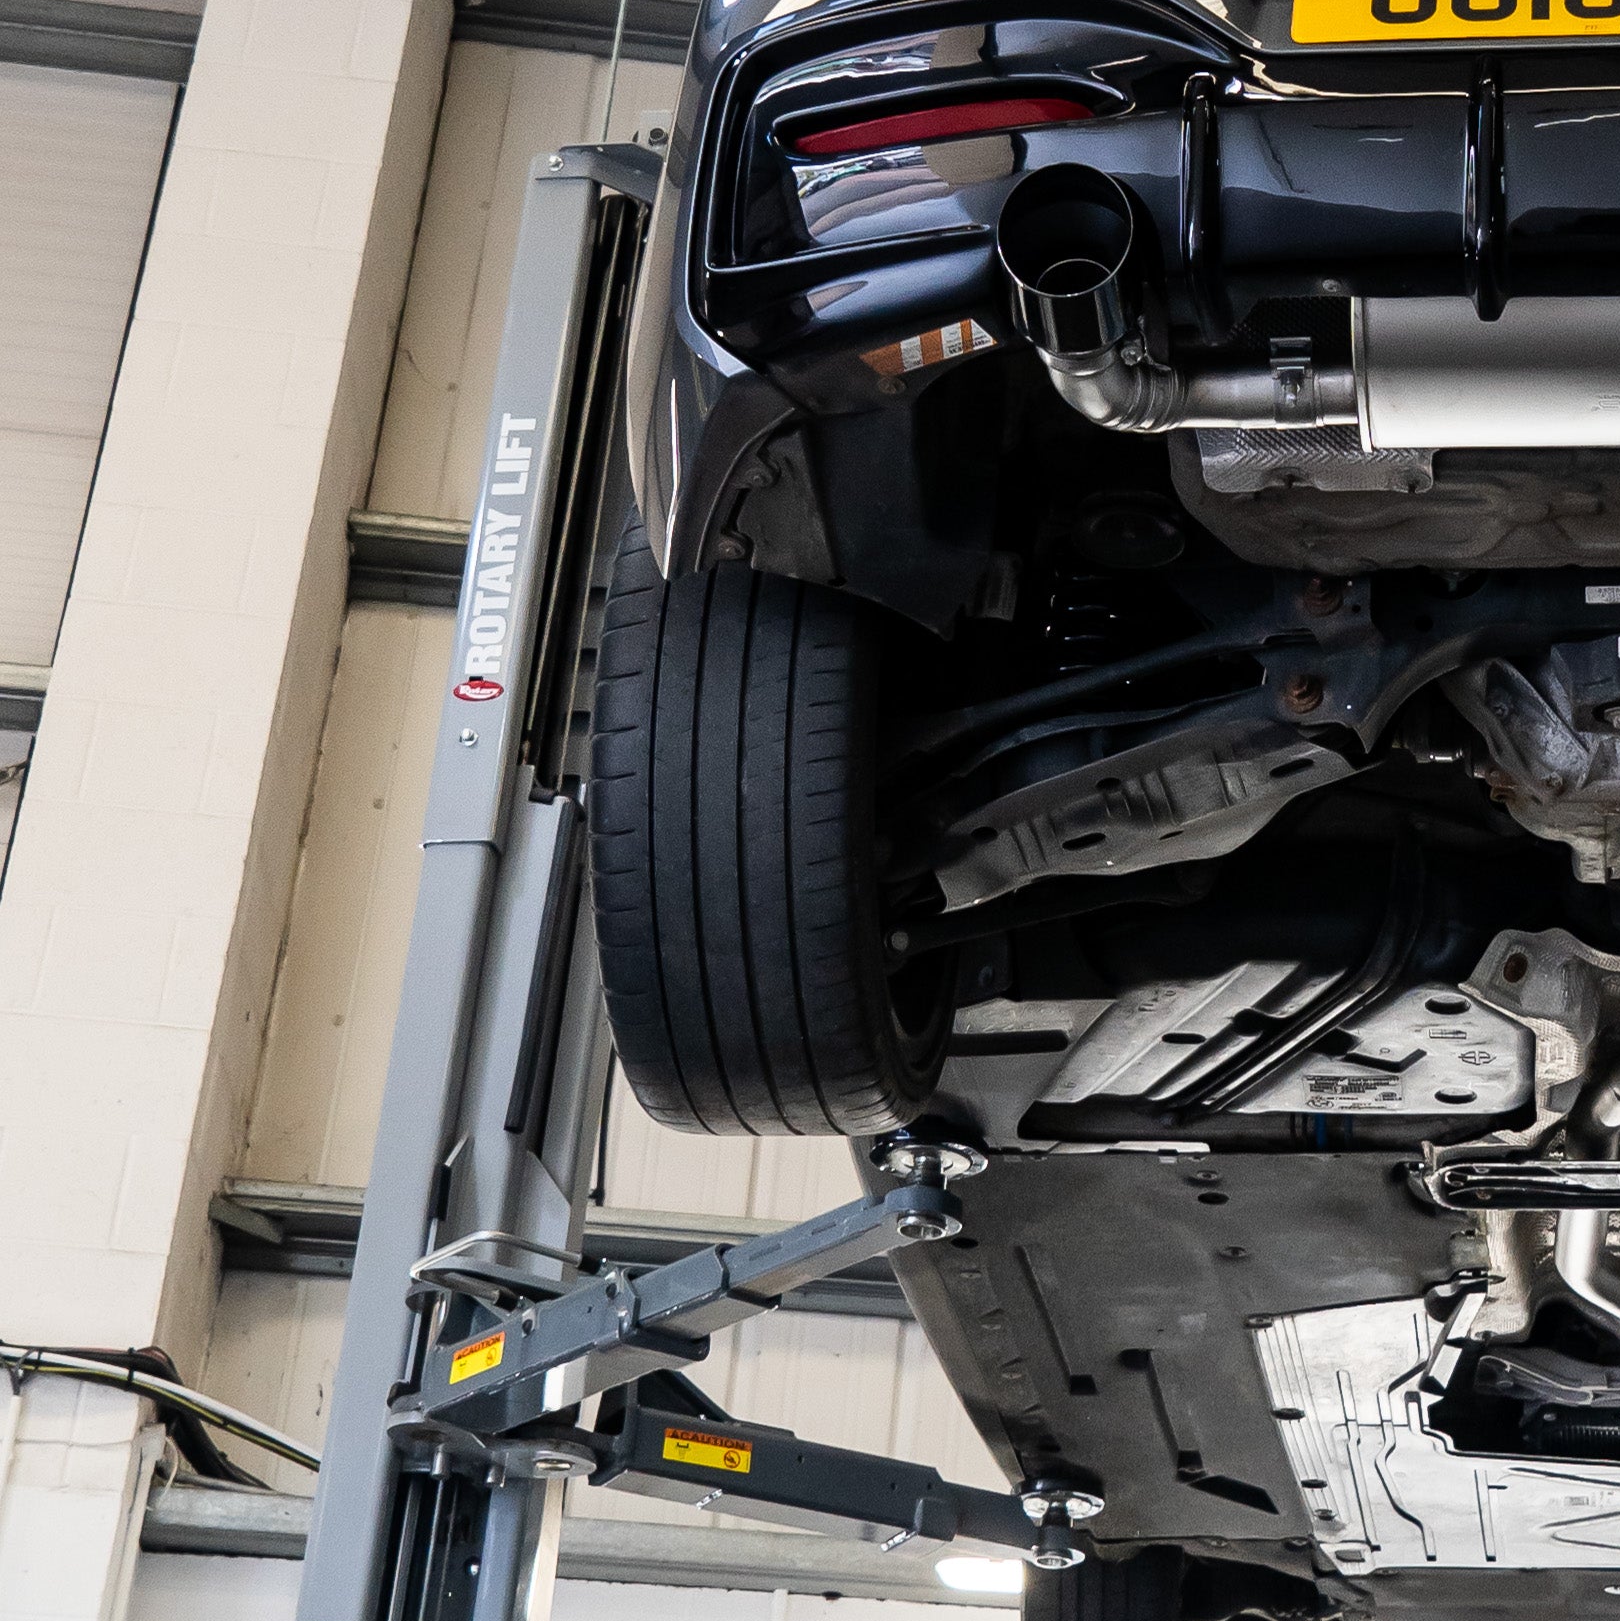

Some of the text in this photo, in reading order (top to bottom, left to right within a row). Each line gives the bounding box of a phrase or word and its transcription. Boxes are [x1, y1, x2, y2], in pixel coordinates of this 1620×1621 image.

[465, 412, 538, 676] ROTARY LIFT
[681, 1431, 747, 1451] CAUTION
